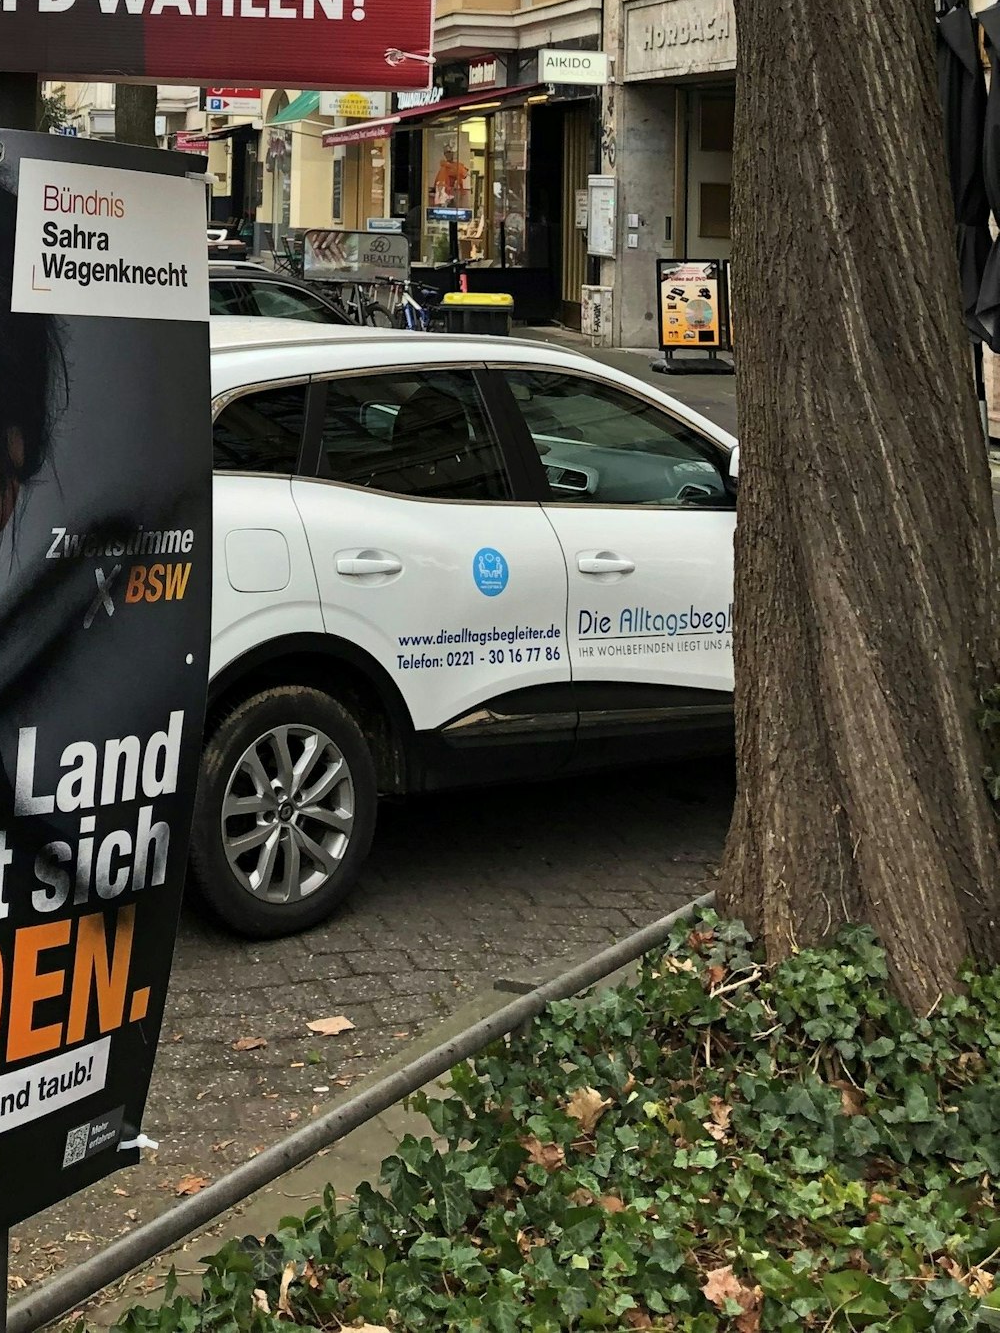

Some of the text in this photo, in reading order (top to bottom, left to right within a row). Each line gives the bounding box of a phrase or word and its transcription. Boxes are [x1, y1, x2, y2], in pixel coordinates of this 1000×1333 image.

[546, 56, 591, 69] AIKIDO
[43, 185, 126, 218] Bündnis
[42, 221, 110, 251] Sahra
[42, 253, 188, 288] Wagenknecht
[363, 254, 405, 264] BEAUTY
[125, 562, 193, 604] BSW
[398, 623, 561, 646] www.diealltagsbegleiter.de
[578, 610, 611, 635] Die
[397, 653, 443, 670] Telefon:
[446, 650, 475, 667] 0221
[488, 649, 505, 664] 30
[509, 648, 523, 663] 16
[526, 647, 541, 662] 77
[545, 646, 561, 661] 86
[578, 646, 595, 658] IHR
[597, 642, 674, 657] WOHLBEFINDEN
[677, 640, 701, 652] LIEGT
[703, 639, 723, 651] UNS
[13, 710, 185, 817] Land
[31, 806, 171, 913] sich
[38, 1056, 95, 1103] taub!
[88, 1129, 117, 1149] erfahren
[91, 1121, 110, 1136] Mehr
